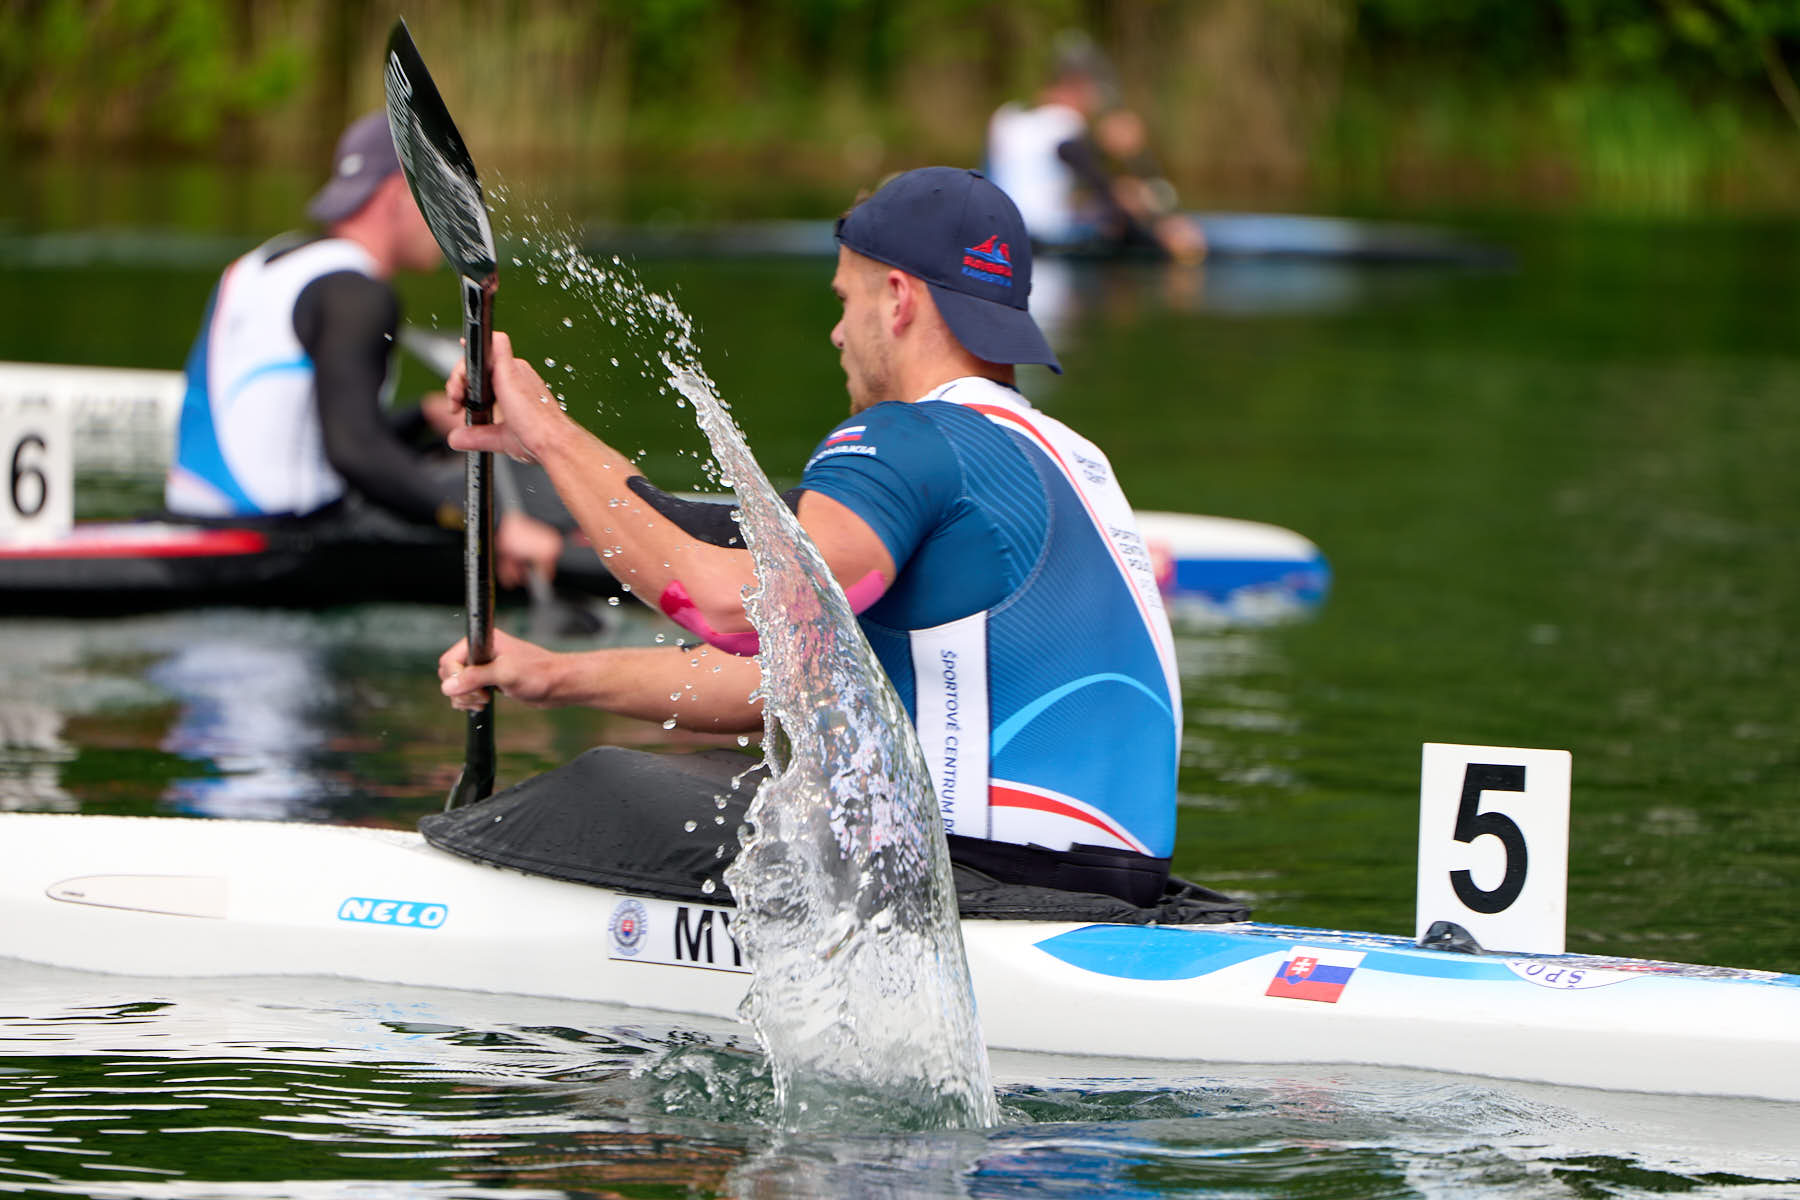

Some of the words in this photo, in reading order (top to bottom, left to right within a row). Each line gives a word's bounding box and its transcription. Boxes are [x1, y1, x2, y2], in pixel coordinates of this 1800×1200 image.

[10, 434, 48, 518] 6
[940, 649, 962, 732] ŠPORTOVÉ
[940, 735, 960, 814] CENTRUM
[1449, 762, 1528, 915] 5
[339, 899, 446, 927] NELO
[1513, 960, 1586, 990] ŠPO
